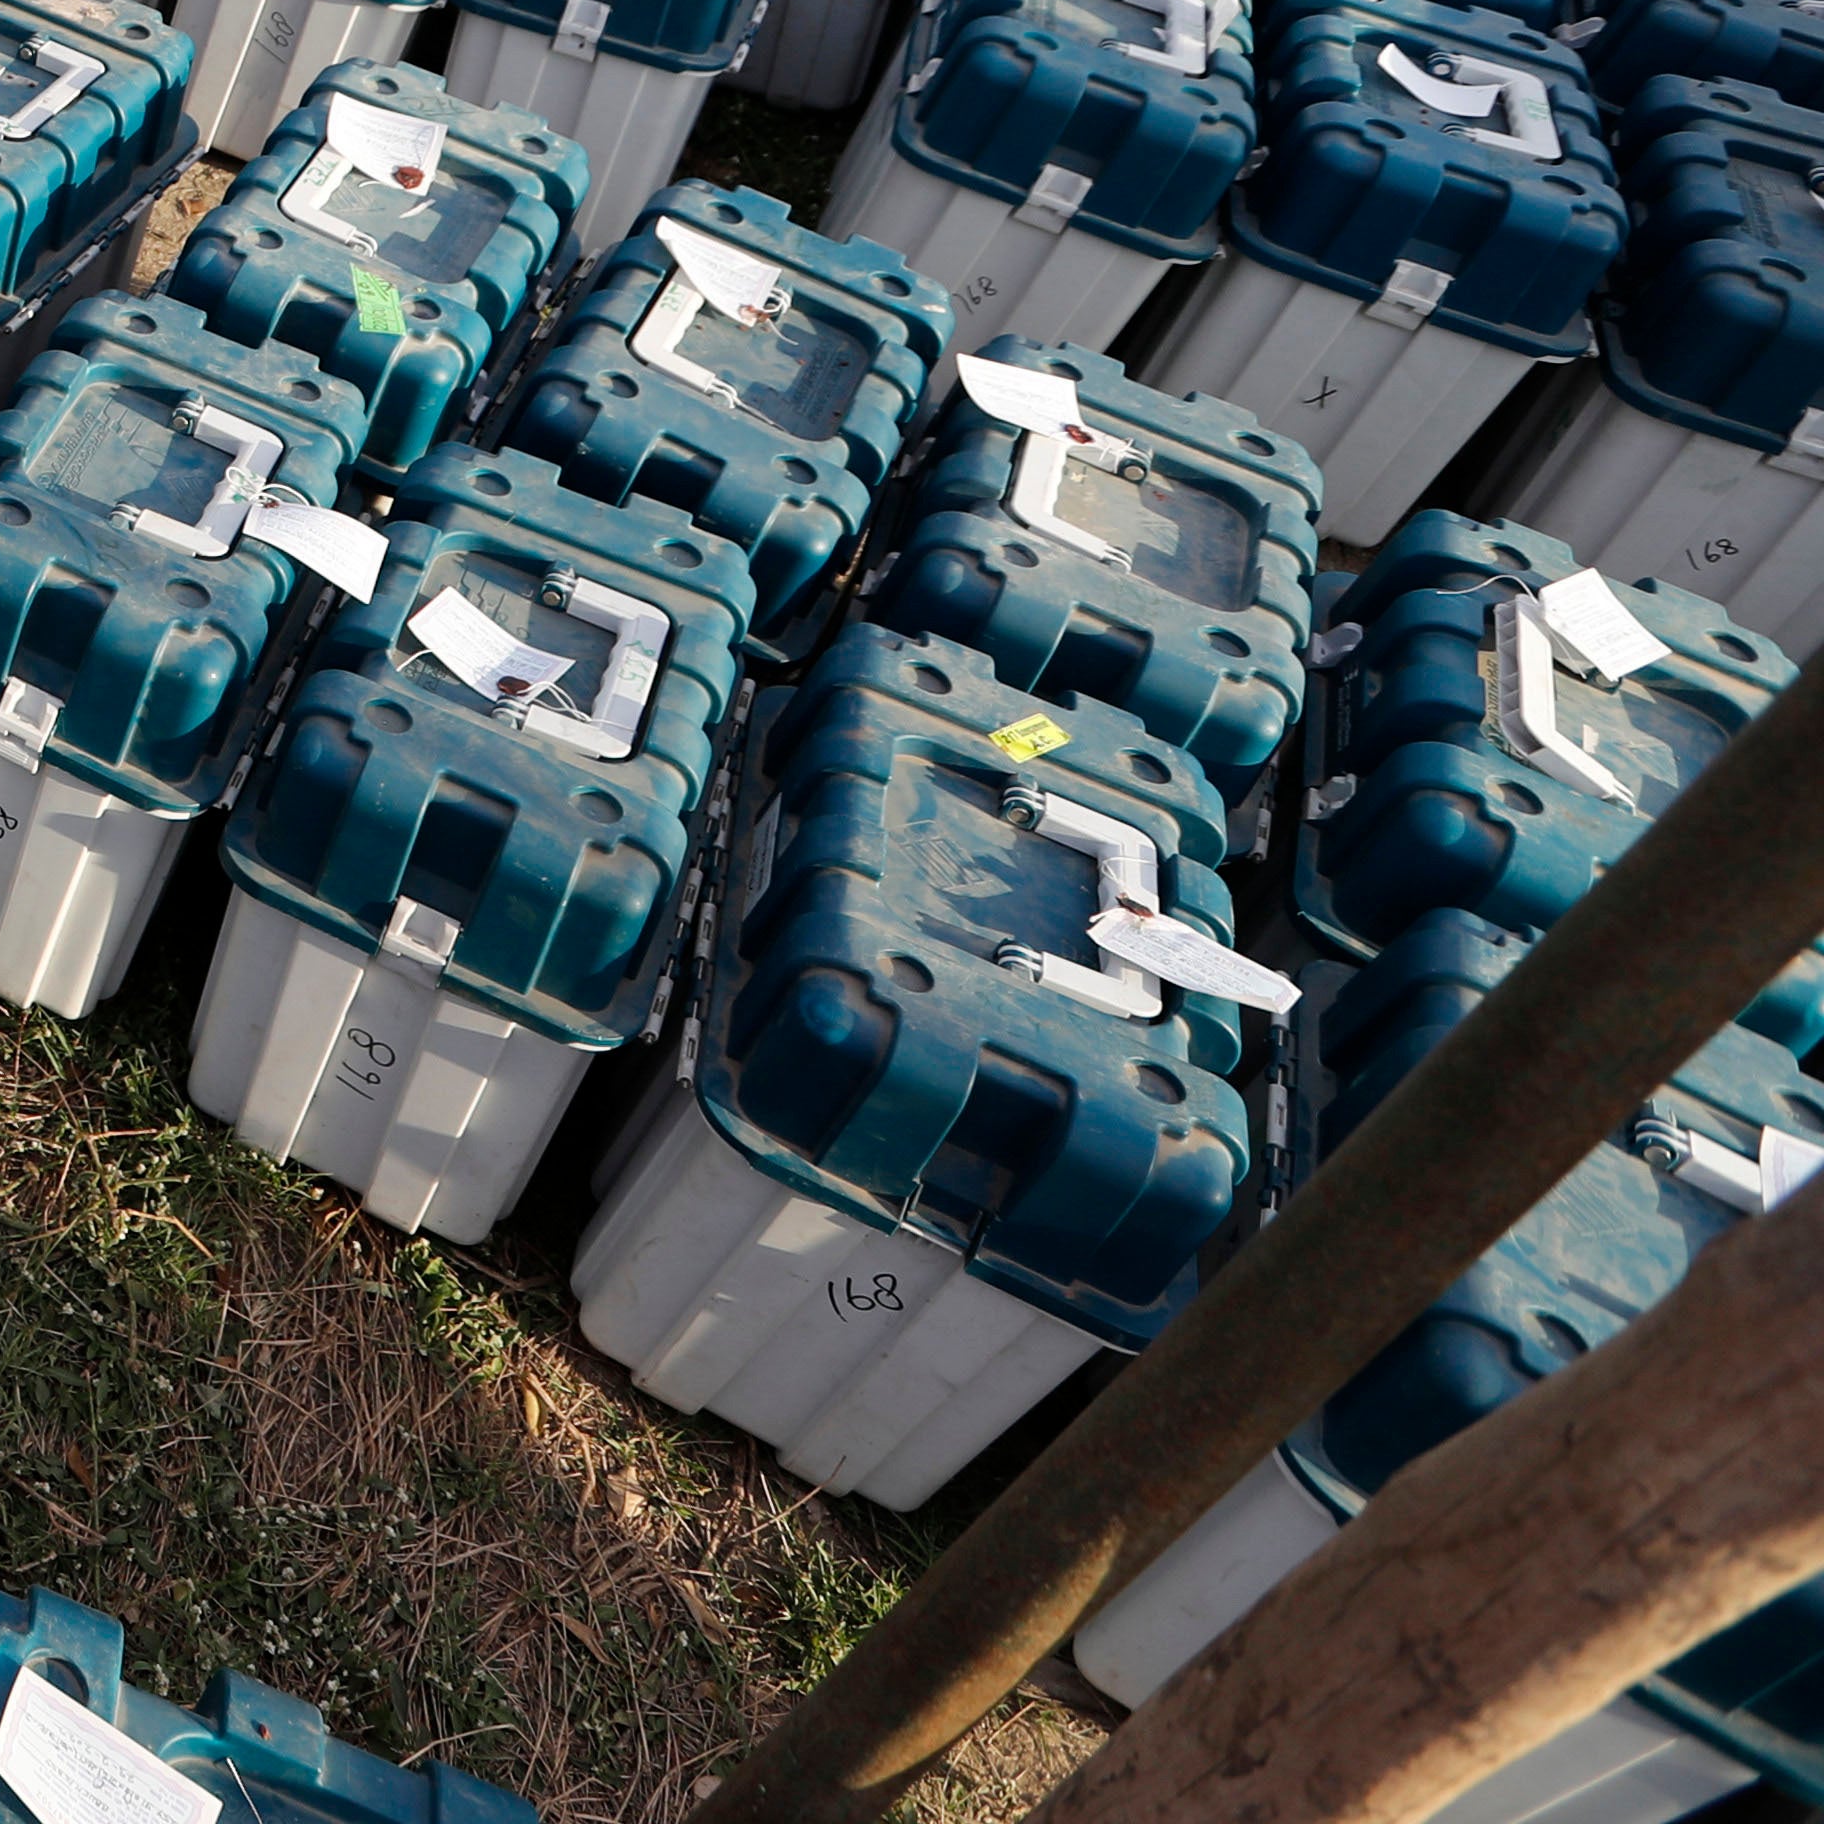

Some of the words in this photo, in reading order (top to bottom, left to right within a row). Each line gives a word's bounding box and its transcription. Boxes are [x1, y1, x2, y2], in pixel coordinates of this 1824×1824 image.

[254, 11, 295, 64] 168
[335, 1028, 396, 1102] 168
[826, 1273, 906, 1325] 168
